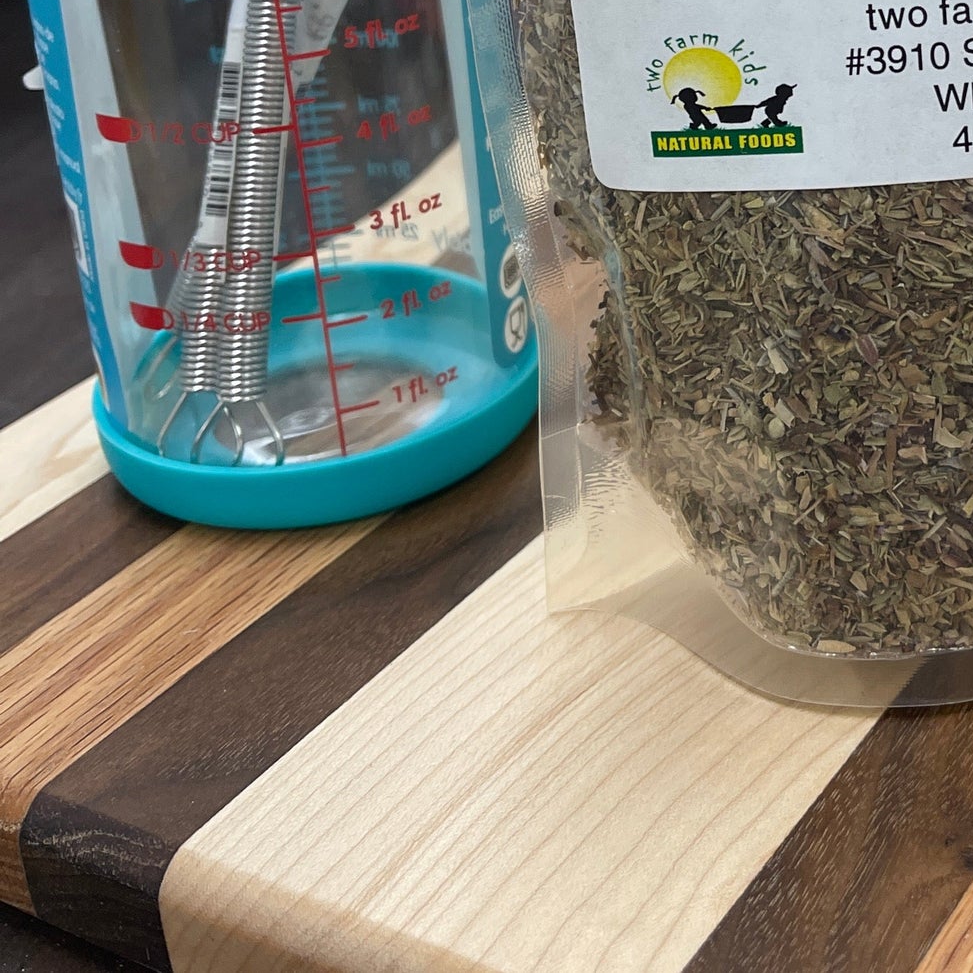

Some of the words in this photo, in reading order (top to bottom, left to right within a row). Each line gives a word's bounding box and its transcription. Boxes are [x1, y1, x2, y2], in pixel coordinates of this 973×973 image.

[343, 26, 359, 49] 5
[365, 19, 388, 49] fl.
[394, 14, 420, 35] oz
[866, 3, 928, 31] two
[645, 58, 664, 93] two
[663, 32, 719, 54] farm
[727, 38, 768, 87] kids
[845, 41, 951, 76] #3910
[191, 121, 242, 144] CUP
[356, 120, 372, 140] 4
[379, 111, 400, 141] fl.
[407, 105, 432, 126] oz
[656, 135, 733, 152] NATURAL
[738, 132, 797, 150] FOODS
[369, 210, 384, 230] 3
[390, 200, 411, 229] fl.
[418, 192, 443, 214] oz
[212, 250, 262, 272] CUP
[380, 298, 396, 320] 2
[401, 290, 422, 317] fl.
[428, 281, 452, 301] oz
[223, 312, 272, 333] CUP
[391, 385, 403, 403] 1
[408, 376, 428, 403] fl.
[434, 365, 459, 387] oz
